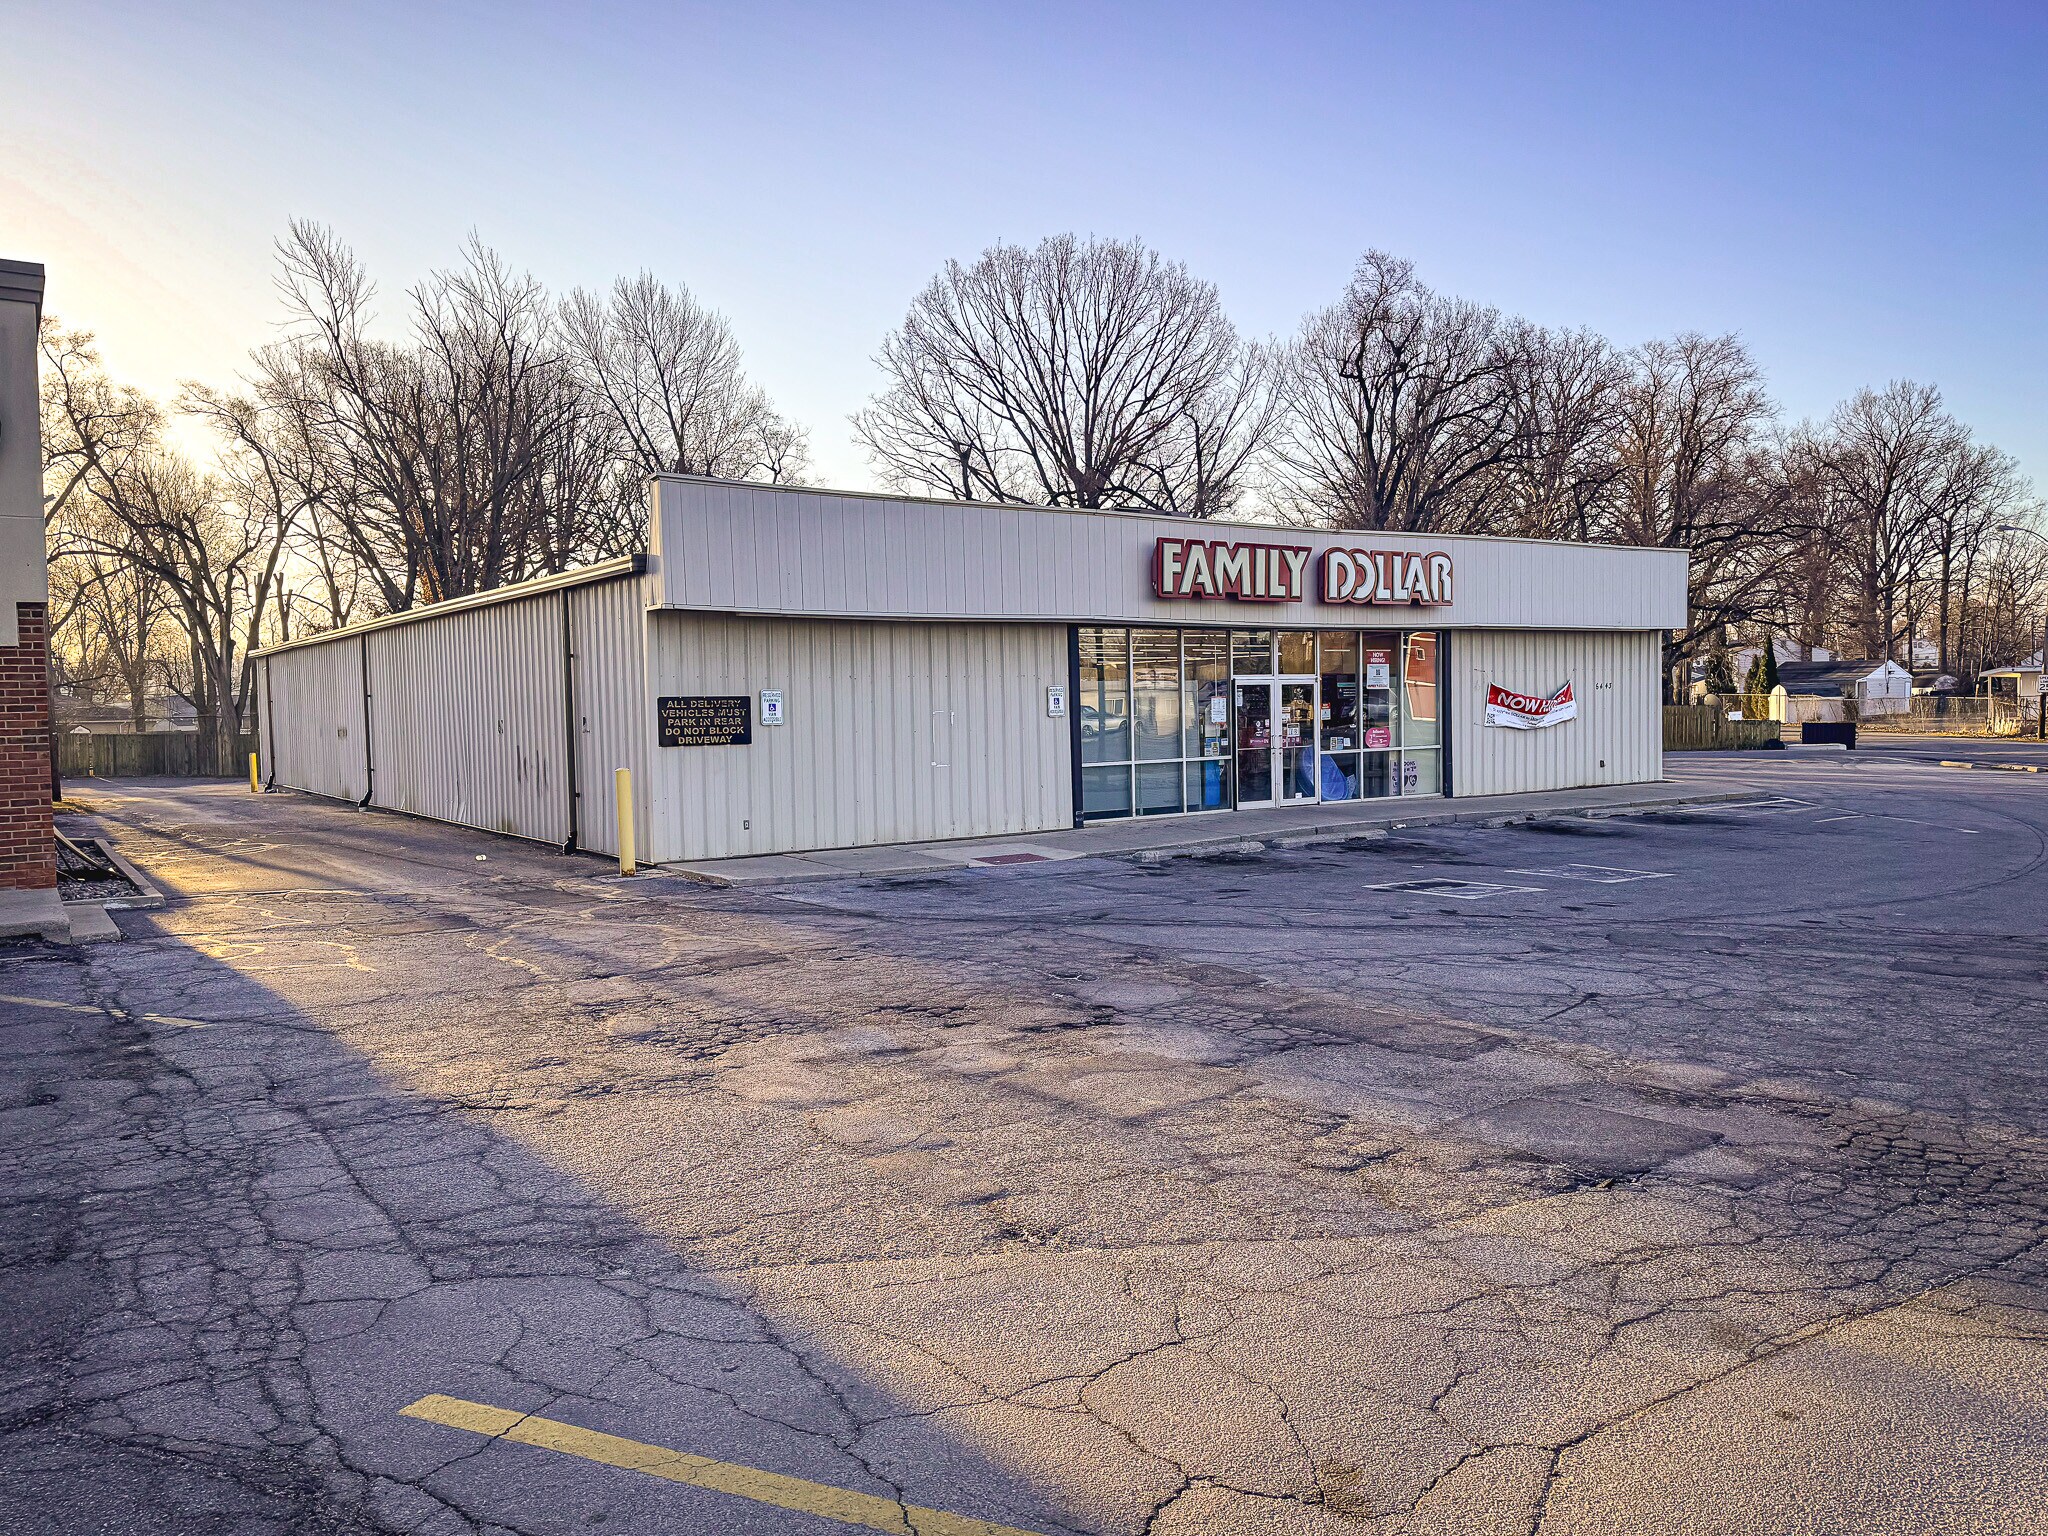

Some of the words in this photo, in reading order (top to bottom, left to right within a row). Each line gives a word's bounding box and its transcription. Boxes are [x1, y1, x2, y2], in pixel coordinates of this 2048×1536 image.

[1160, 541, 1309, 599] FAMILY
[1326, 550, 1452, 602] DOLLAR
[667, 700, 687, 708] ALL
[690, 700, 741, 708] DELIVERY
[1497, 692, 1540, 713] NOW
[661, 709, 715, 717] VEHICLES
[717, 708, 747, 716] MUST
[667, 718, 696, 726] PARK
[700, 718, 711, 726] IN
[714, 717, 742, 725] REAR
[665, 727, 681, 736] DO
[683, 727, 706, 735] NOT
[709, 726, 745, 735] BLOCK
[678, 735, 733, 745] DRIVEWAY
